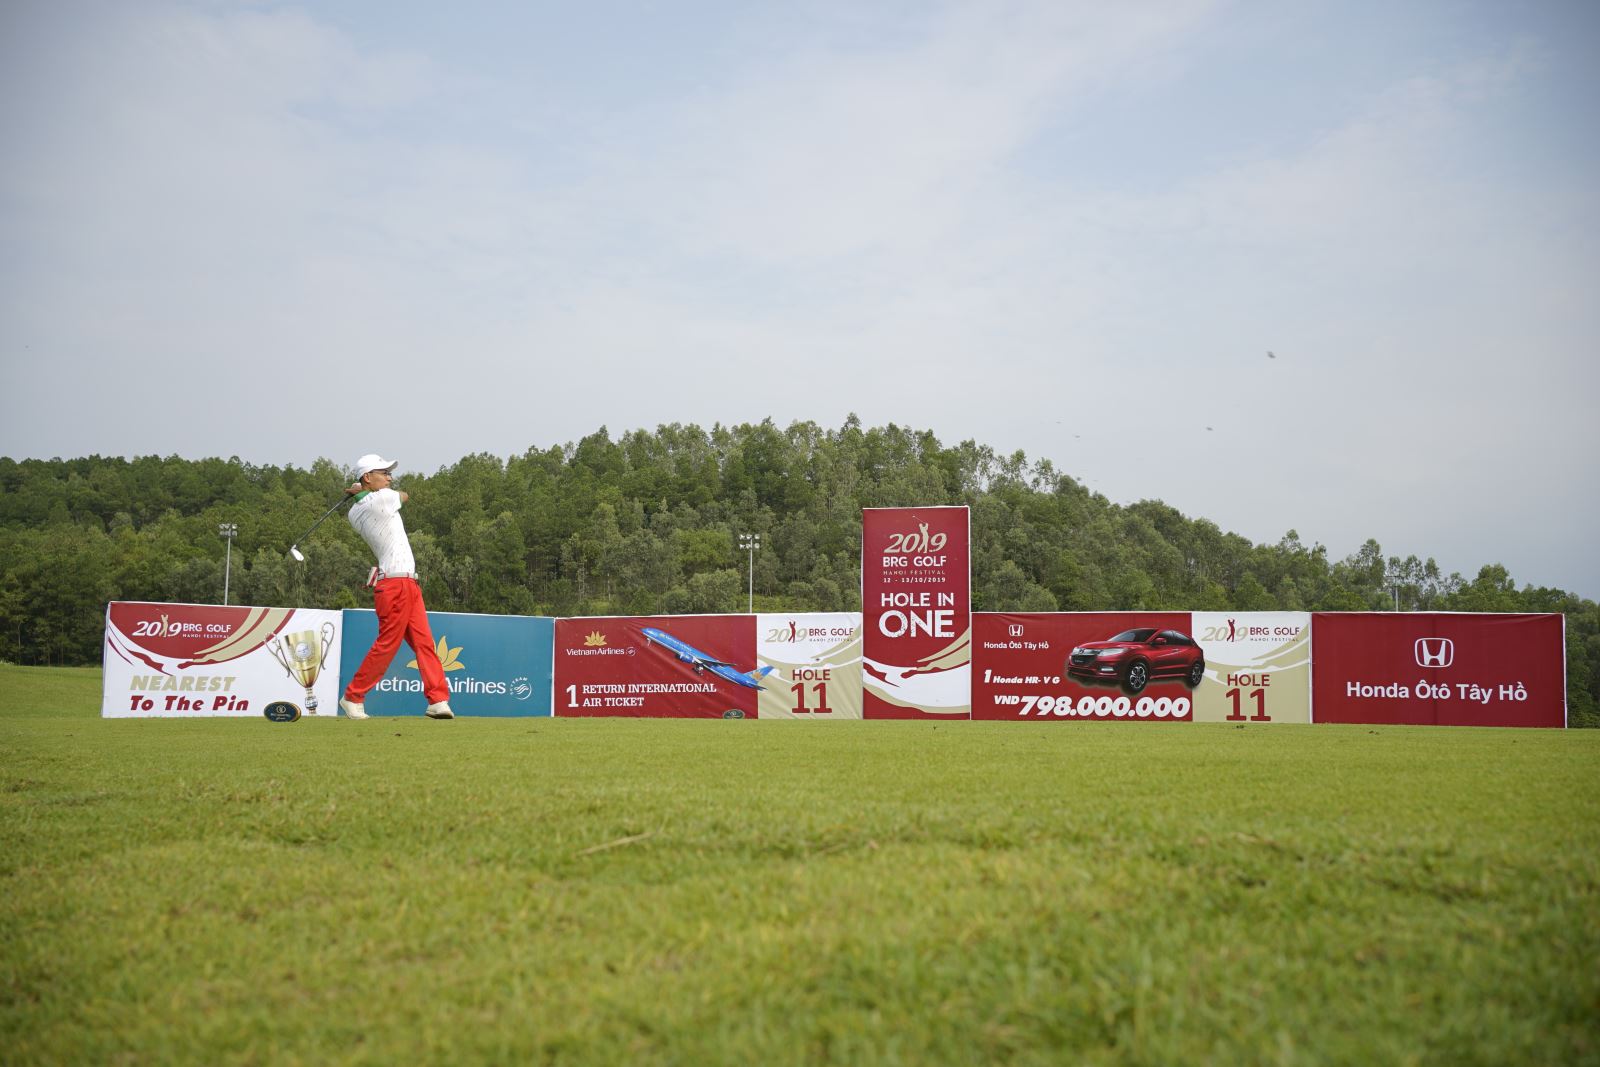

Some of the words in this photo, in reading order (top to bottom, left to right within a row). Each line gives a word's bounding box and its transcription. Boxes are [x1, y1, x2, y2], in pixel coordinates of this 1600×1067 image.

[883, 528, 947, 553] 2019
[883, 556, 908, 567] BRG
[914, 556, 947, 567] GOLF
[881, 592, 931, 607] HOLE
[938, 592, 954, 606] IN
[132, 617, 182, 637] 2019
[182, 623, 202, 632] BRG
[206, 624, 231, 633] GOLF
[878, 609, 955, 638] ONE
[809, 628, 826, 636] BRG
[830, 628, 854, 636] GOLF
[1249, 627, 1269, 636] BRG
[1274, 627, 1300, 636] GOLF
[566, 648, 597, 656] Vietnam
[597, 647, 625, 655] Airlines
[984, 641, 1007, 649] Honda
[1009, 641, 1022, 649] Ôtô
[1024, 642, 1037, 650] Tây
[792, 669, 831, 681] HOLE
[984, 669, 992, 683] 1
[993, 676, 1023, 684] Honda
[1052, 676, 1060, 684] G
[1227, 674, 1270, 687] HOLE
[130, 675, 236, 692] NEAREST
[374, 676, 425, 692] ietna
[445, 677, 506, 694] Airlines
[582, 685, 626, 694] RETURN
[628, 683, 717, 693] INTERNATIONAL
[566, 684, 579, 708] 1
[791, 682, 832, 714] 11
[1346, 681, 1409, 698] Honda
[1415, 679, 1451, 699] Ôtô
[1456, 683, 1493, 704] Tây
[1499, 681, 1528, 701] Hồ
[130, 695, 154, 711] To
[165, 695, 204, 711] The
[212, 695, 249, 711] Pin
[582, 698, 602, 707] AIR
[604, 697, 645, 707] TICKET
[994, 695, 1020, 705] VND
[1018, 696, 1190, 717] 798.000.000
[1226, 688, 1271, 721] 11
